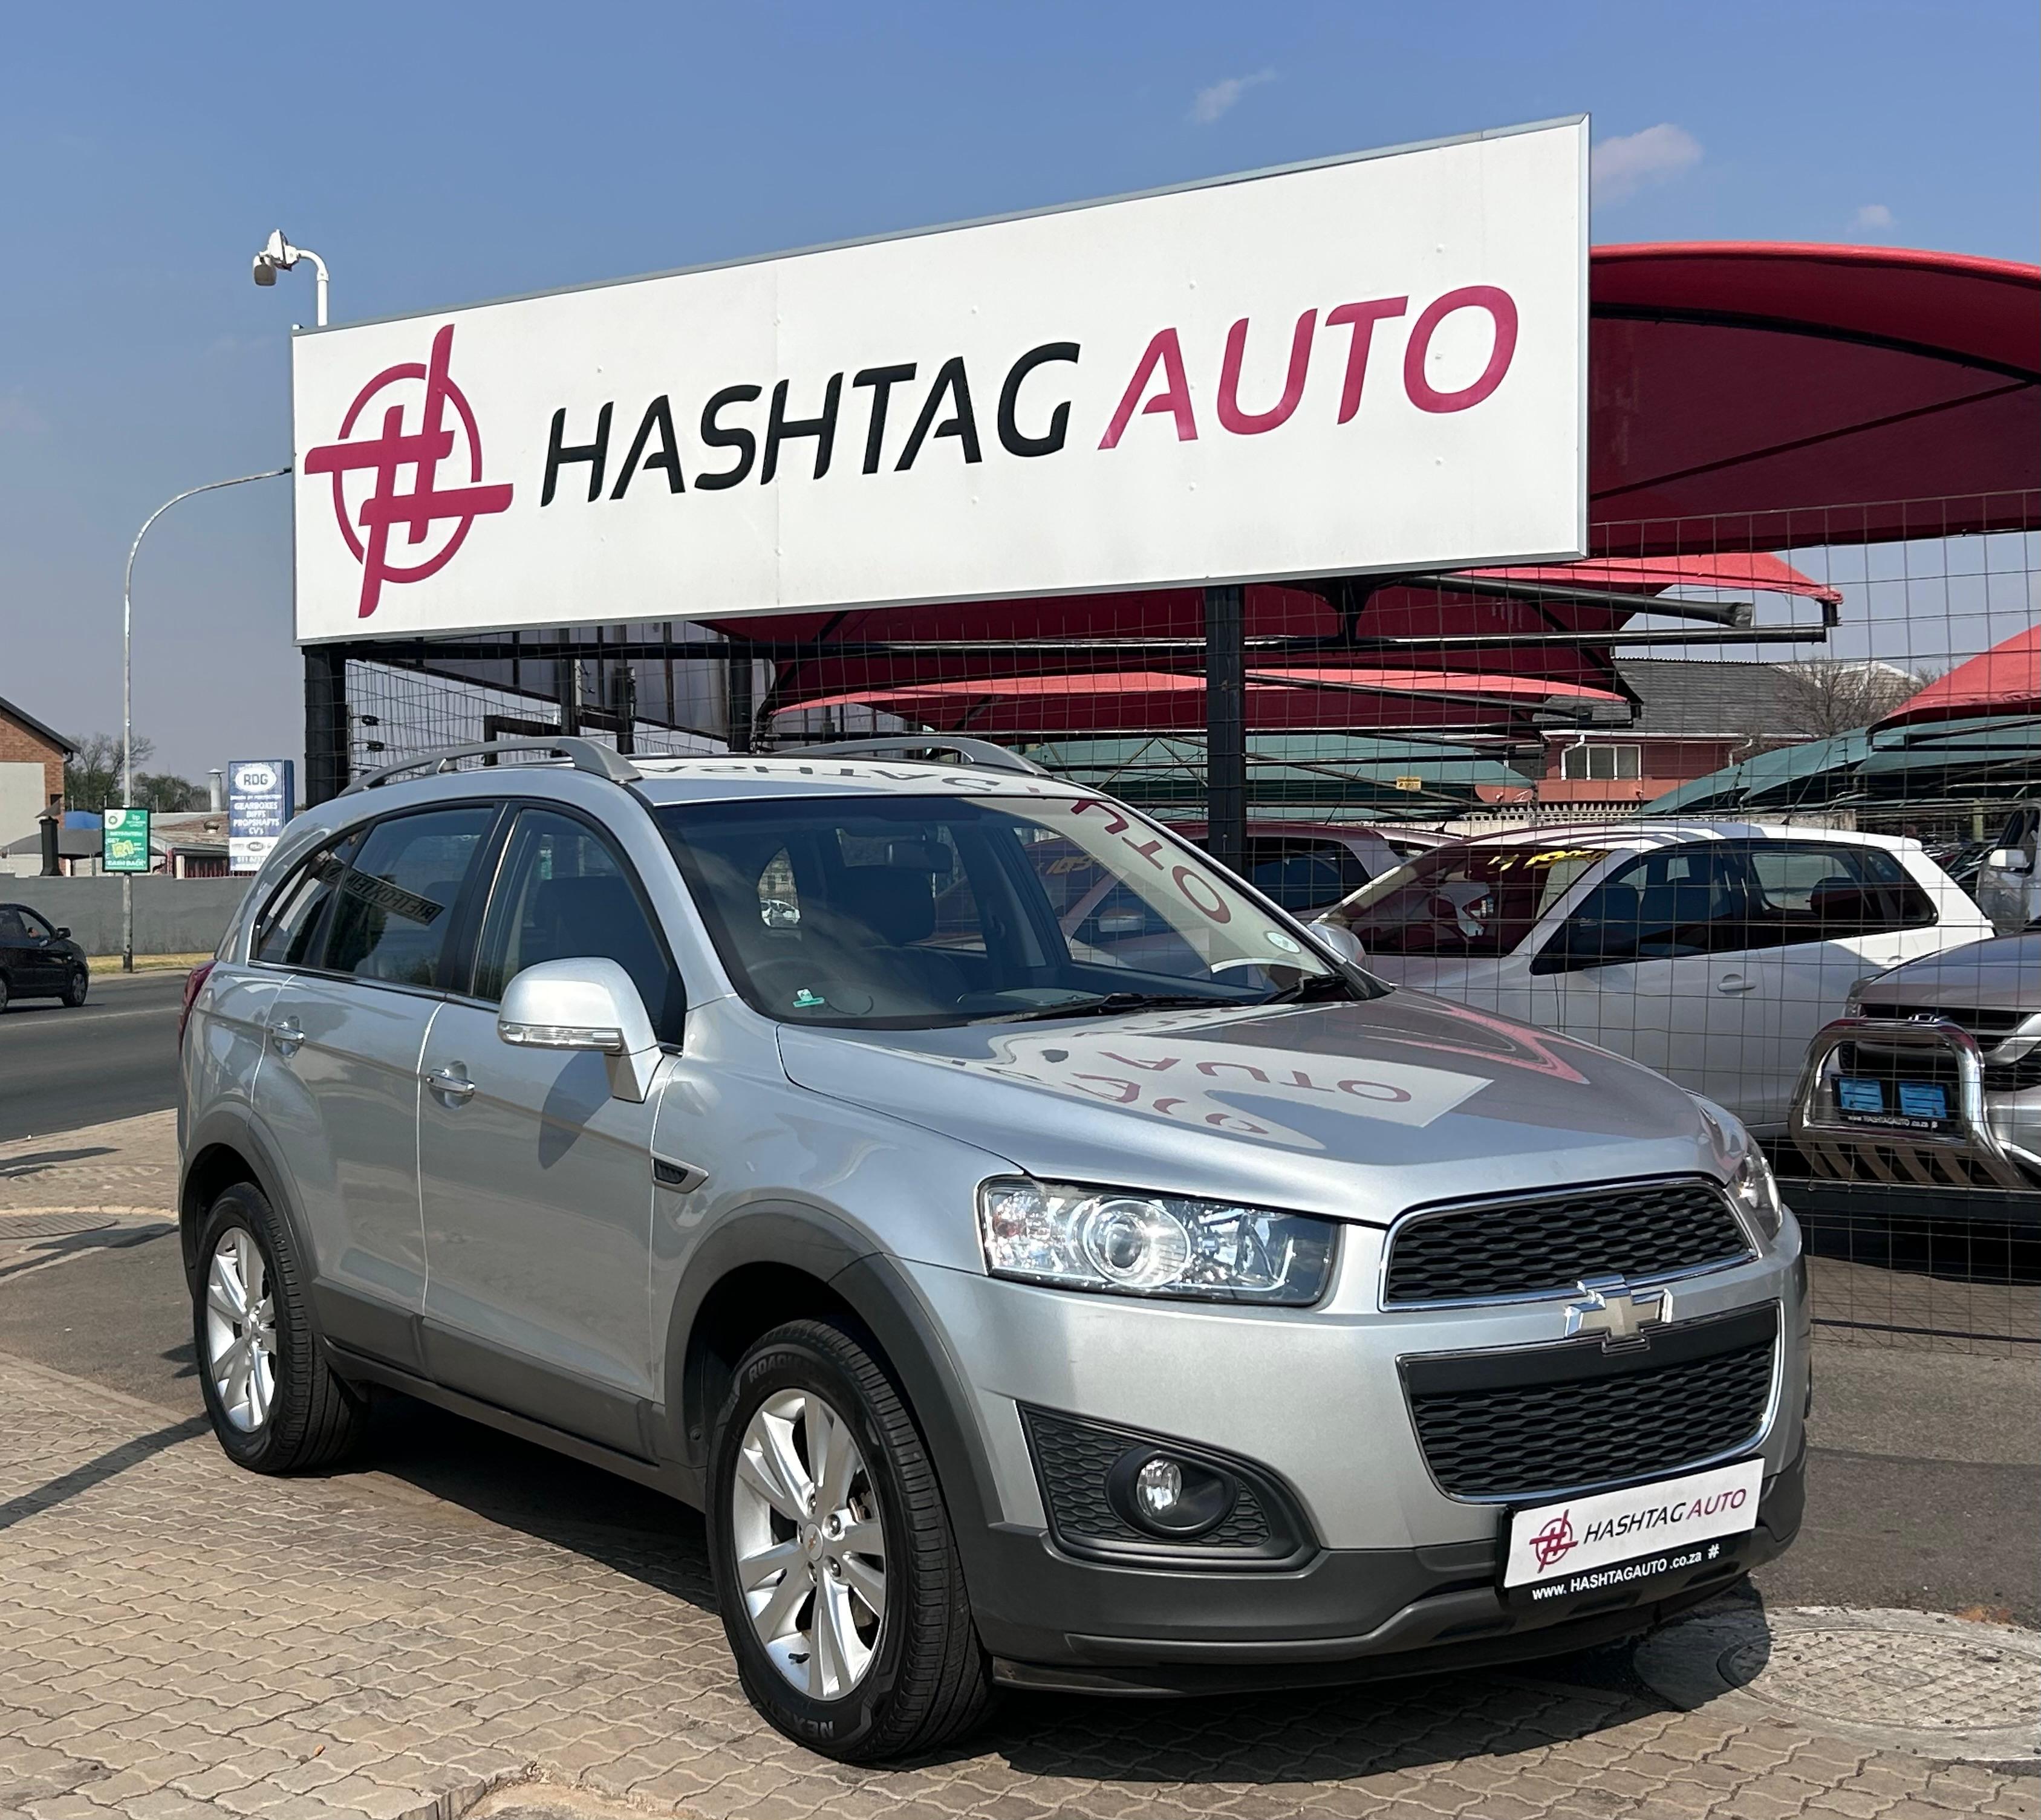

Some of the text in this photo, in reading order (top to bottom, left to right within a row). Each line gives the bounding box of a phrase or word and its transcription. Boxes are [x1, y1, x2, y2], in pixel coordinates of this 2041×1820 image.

[541, 285, 1518, 507] HASHTAG AUTO
[244, 774, 268, 785] RDG
[1583, 1488, 1746, 1544] HASHTAG AUTO
[1532, 1583, 1567, 1600] www.
[1571, 1558, 1667, 1593] HASHTAGAUTO
